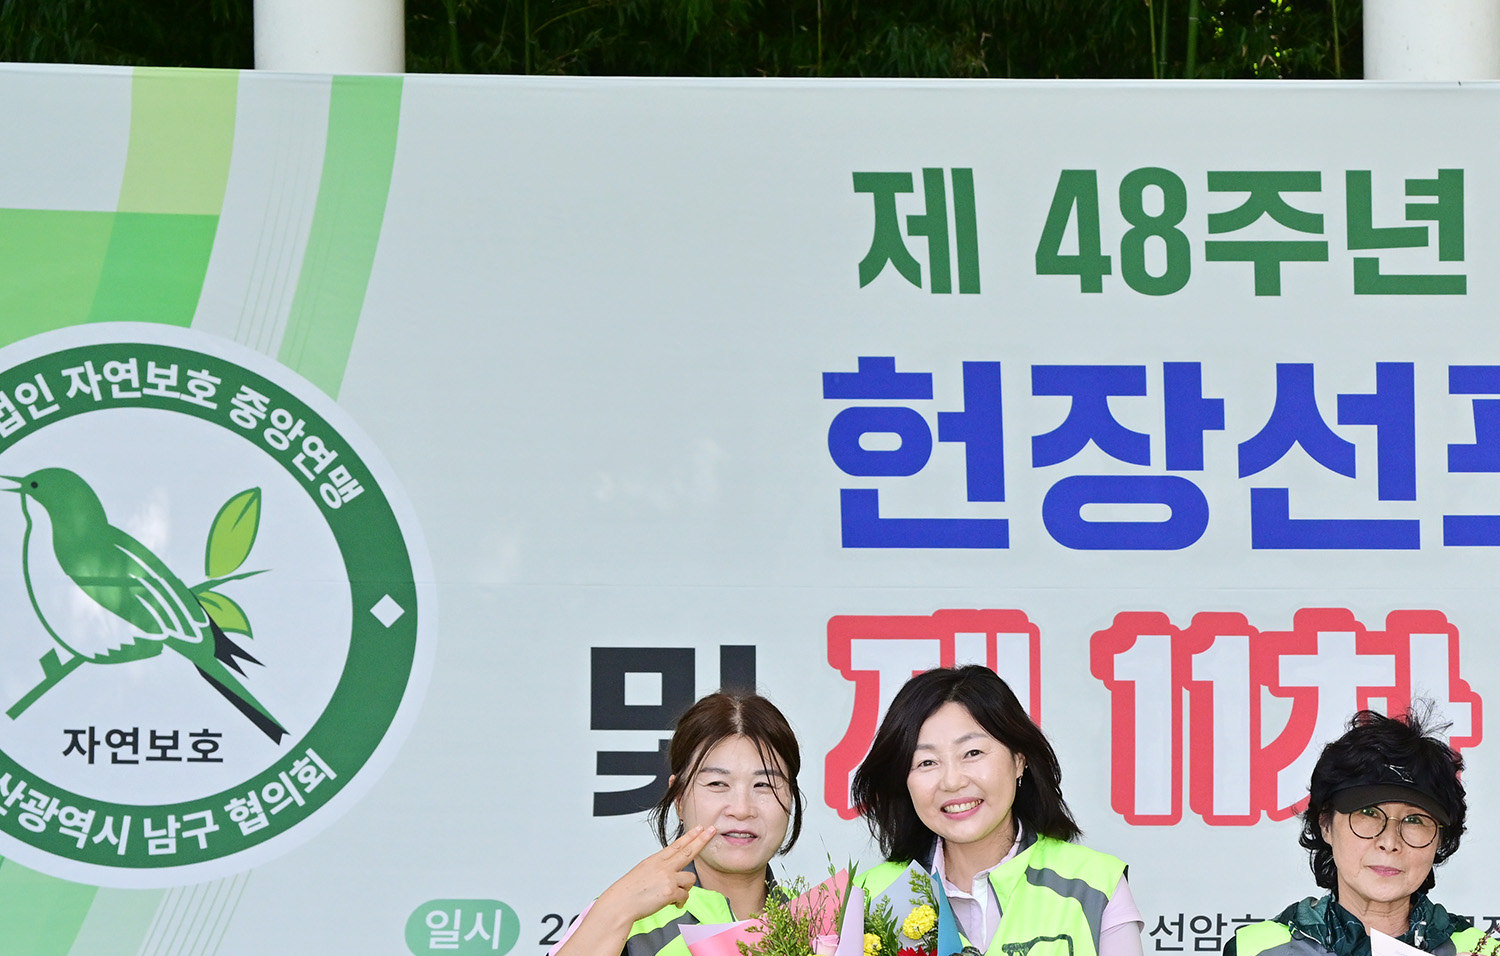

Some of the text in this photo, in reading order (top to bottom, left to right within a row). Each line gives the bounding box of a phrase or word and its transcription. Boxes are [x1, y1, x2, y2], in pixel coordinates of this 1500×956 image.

[852, 167, 981, 294] 제
[1035, 166, 1467, 297] 48주년
[61, 358, 221, 410] 자연보호
[230, 385, 364, 509] 중앙연맹
[62, 727, 224, 765] 자연보호
[143, 809, 219, 855] 남구
[224, 747, 337, 836] 협의회
[426, 909, 502, 950] 일시
